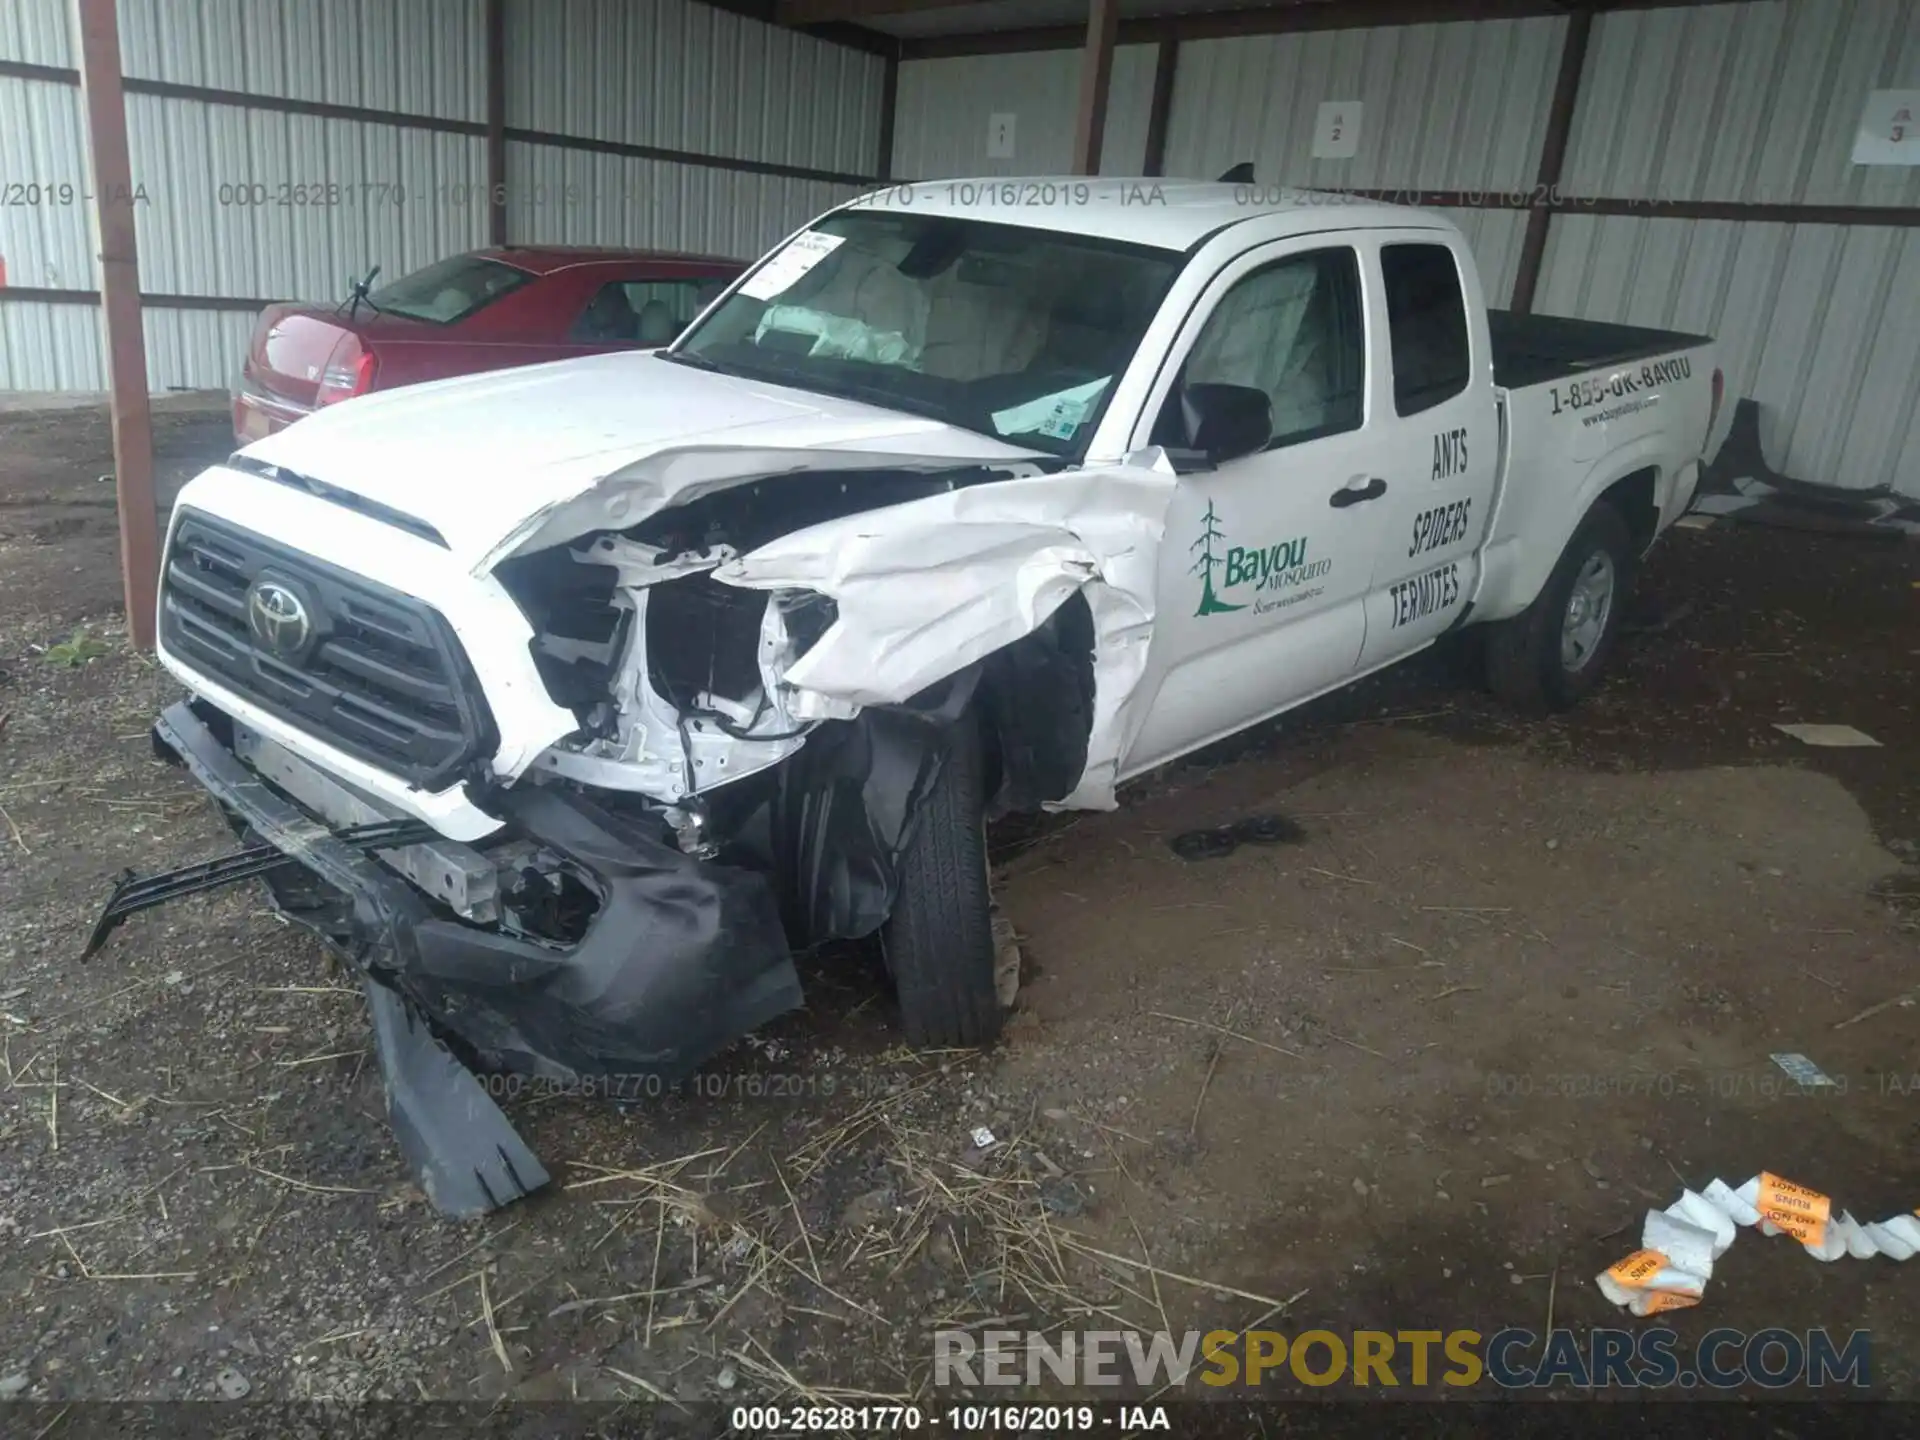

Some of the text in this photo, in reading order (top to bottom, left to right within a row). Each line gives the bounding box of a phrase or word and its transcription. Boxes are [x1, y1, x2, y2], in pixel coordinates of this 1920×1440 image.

[1331, 127, 1342, 142] 2
[1432, 427, 1468, 481] ANTS
[1408, 496, 1472, 558] SPIDERS
[1224, 536, 1308, 591] Bayou
[1389, 562, 1460, 630] TERMITES
